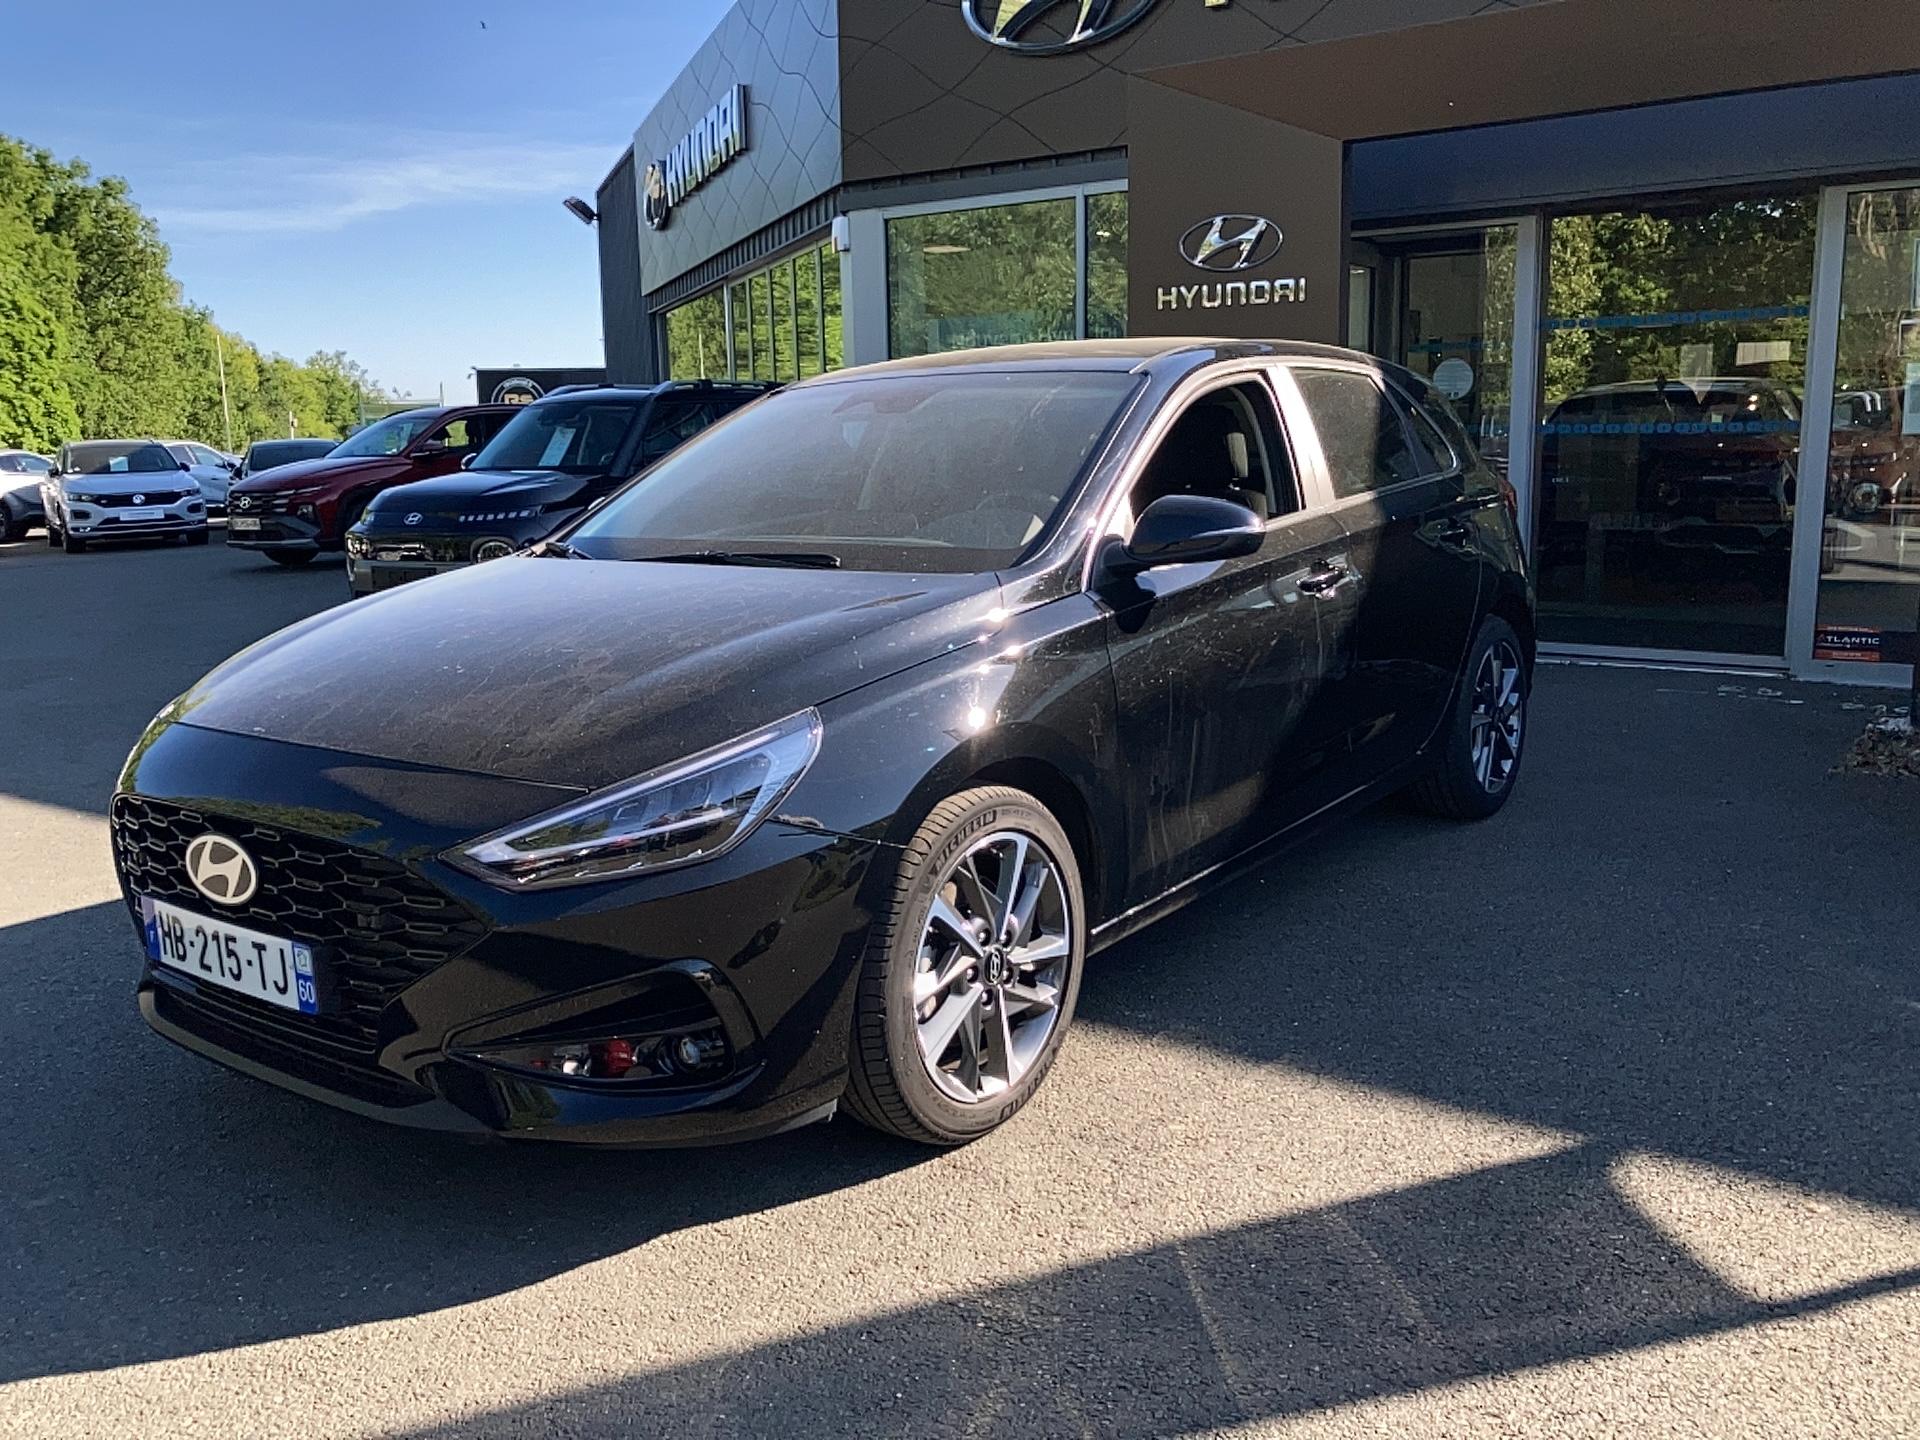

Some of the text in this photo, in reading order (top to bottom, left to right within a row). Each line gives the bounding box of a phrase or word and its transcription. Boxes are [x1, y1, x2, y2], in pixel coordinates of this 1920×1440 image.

[666, 84, 744, 207] HYUNDAI
[1157, 277, 1306, 310] HYUNDAI
[158, 911, 289, 995] HB-215-TJ
[299, 980, 316, 1003] 60
